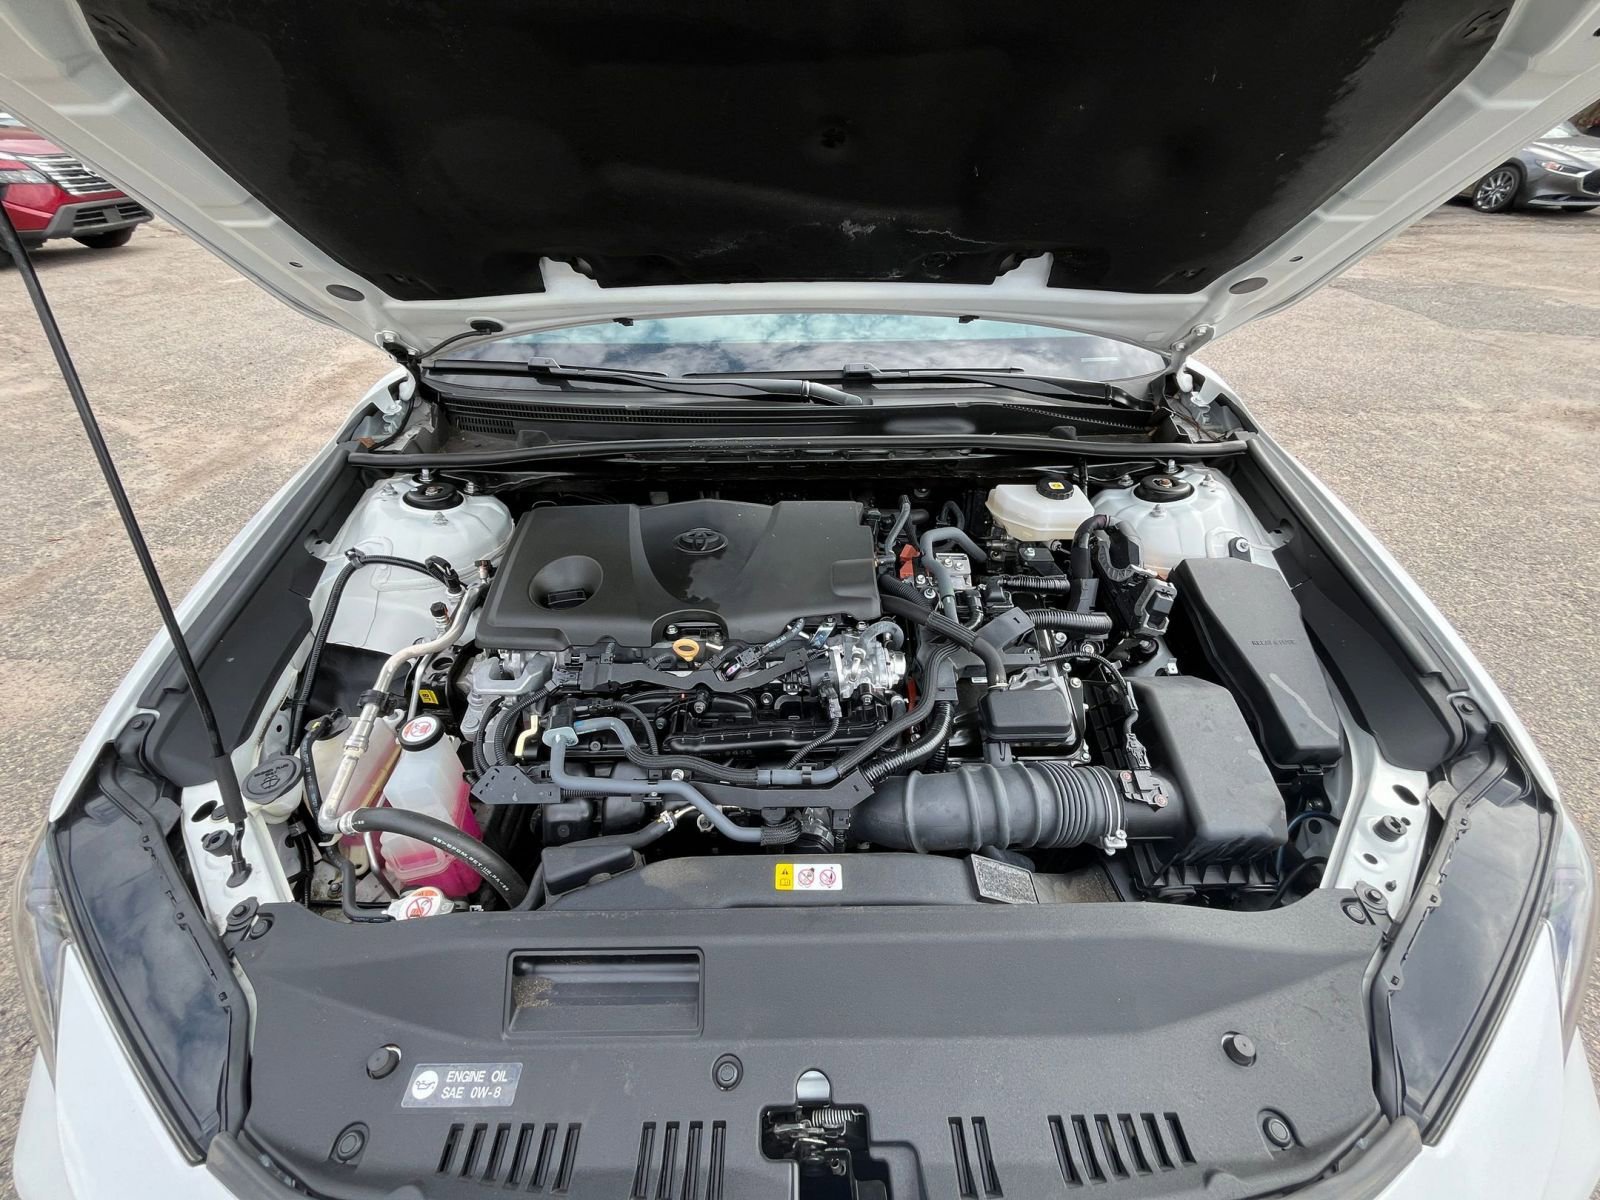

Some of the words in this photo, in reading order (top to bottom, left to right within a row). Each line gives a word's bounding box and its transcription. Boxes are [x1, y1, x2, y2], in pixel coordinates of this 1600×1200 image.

[446, 1070, 486, 1082] ENGINE
[491, 1070, 508, 1082] OIL
[441, 1086, 465, 1099] SAE
[470, 1086, 502, 1099] 0W-8
